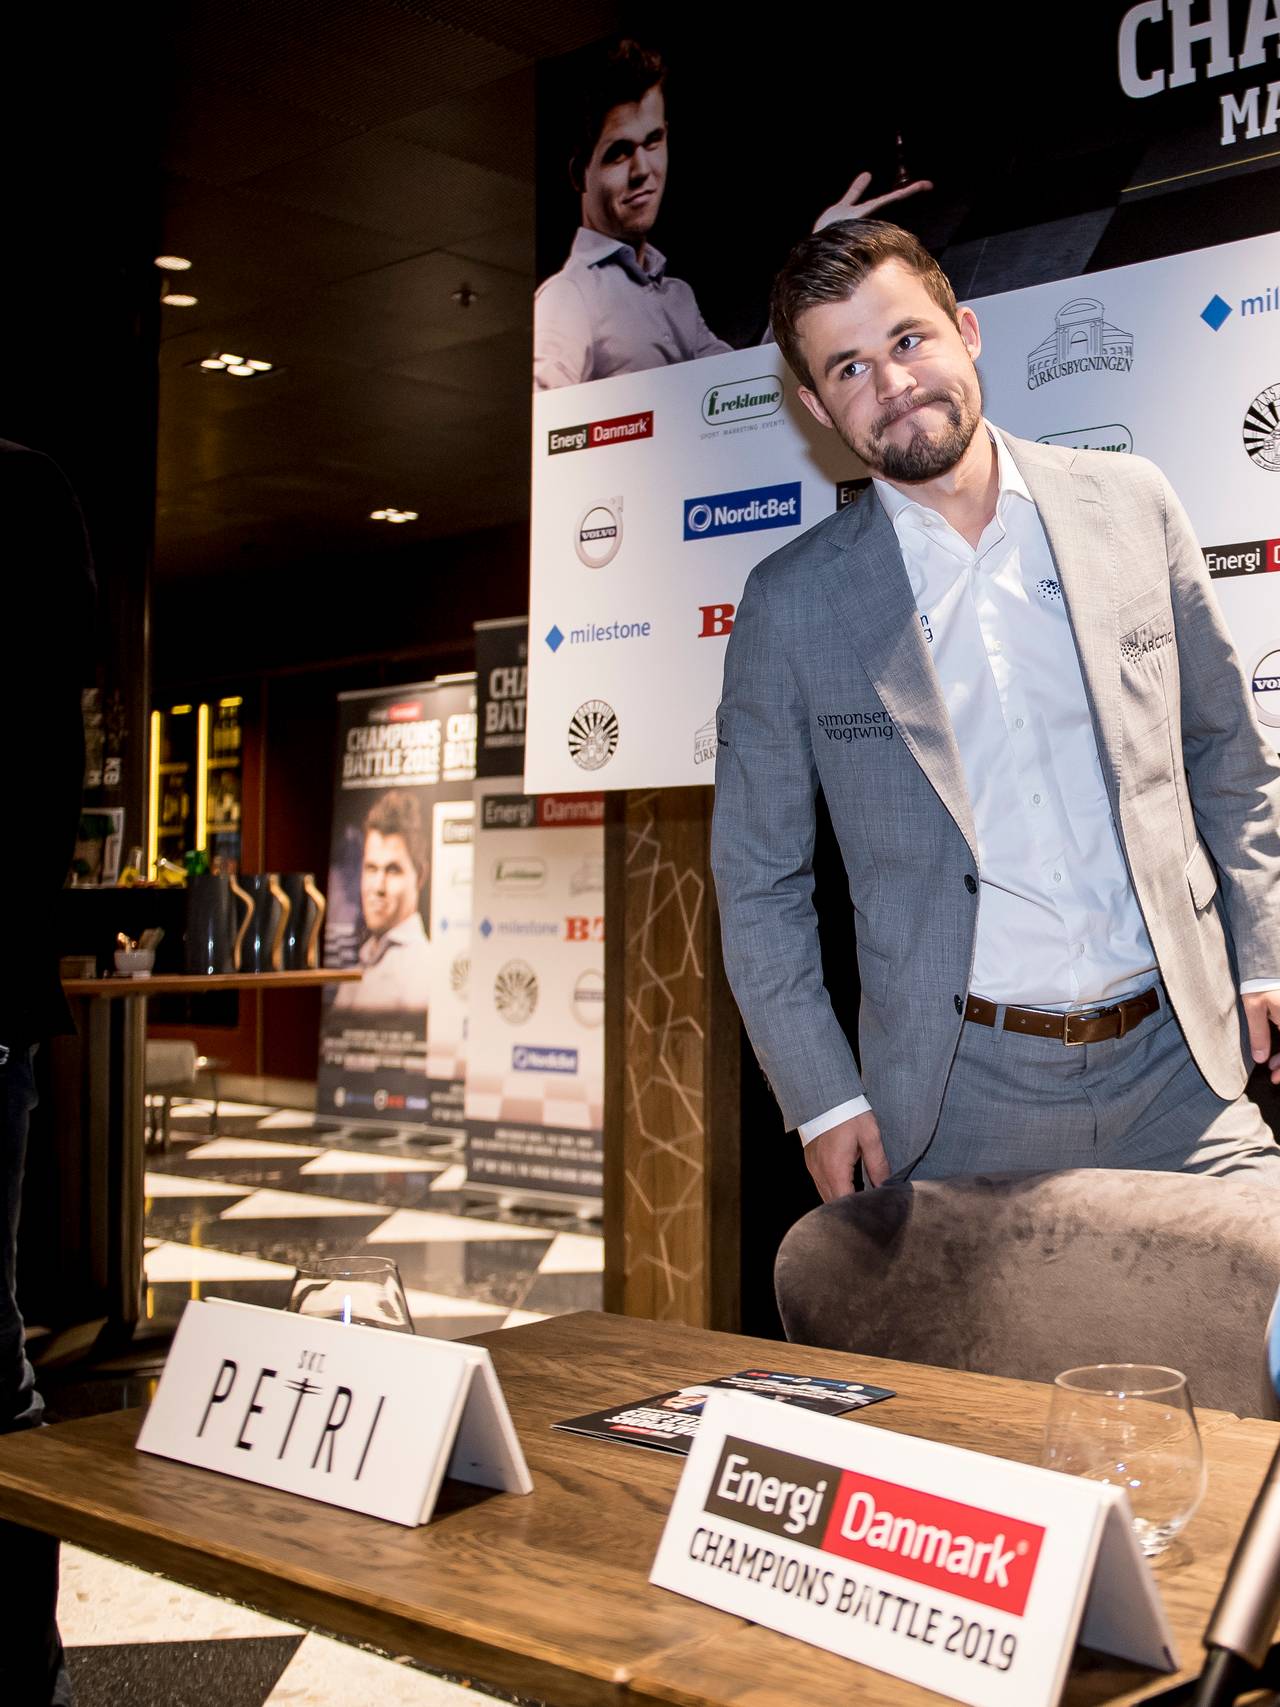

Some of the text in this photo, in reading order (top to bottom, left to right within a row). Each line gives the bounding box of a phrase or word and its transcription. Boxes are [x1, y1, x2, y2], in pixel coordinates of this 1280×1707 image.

[1027, 356, 1134, 391] CIRKUSBYGNINGEN
[708, 390, 780, 416] f.reklame
[550, 418, 648, 450] Energi Danmark
[714, 497, 796, 526] NordicBet
[581, 527, 617, 541] VOLVO
[1205, 548, 1260, 572] Energi
[570, 619, 651, 645] milestone
[1142, 631, 1173, 656] ARCTIC
[817, 711, 893, 727] simonsen
[825, 725, 894, 743] vogtwiig
[196, 1358, 386, 1481] PETRI
[718, 1452, 1017, 1589] Energi Danmark
[689, 1527, 1018, 1672] CHAMPIONS BATTLE 2019
